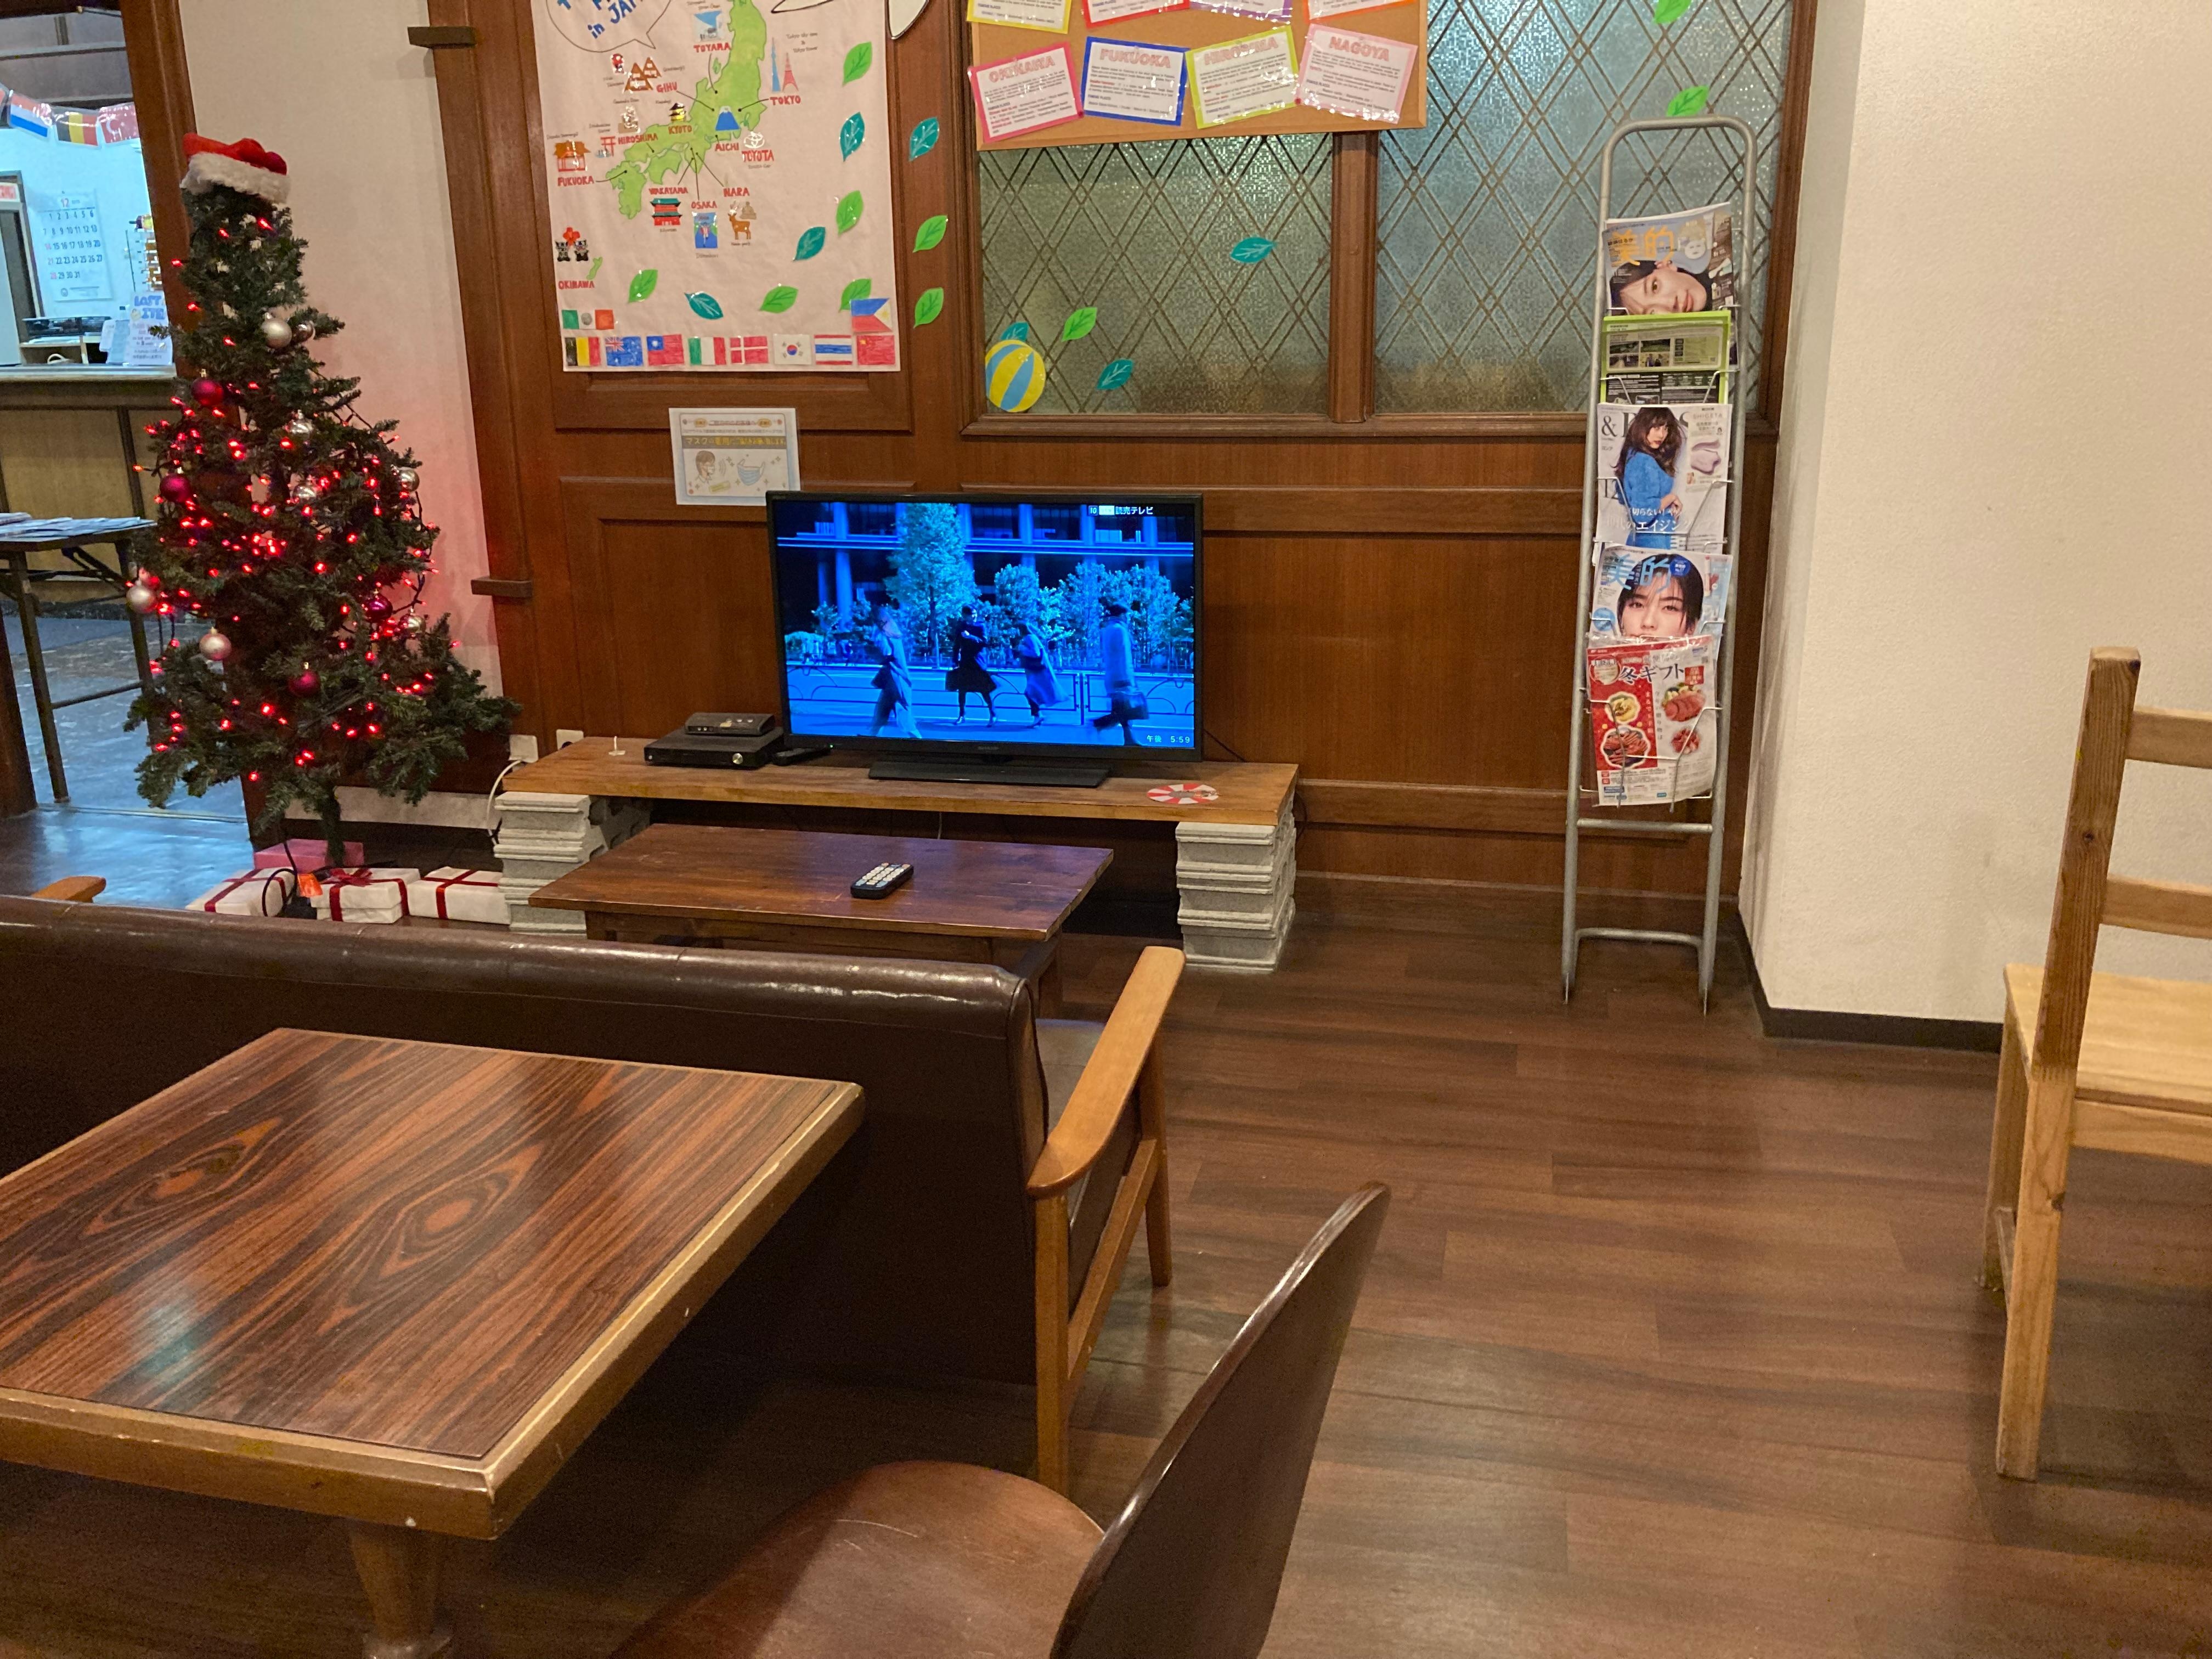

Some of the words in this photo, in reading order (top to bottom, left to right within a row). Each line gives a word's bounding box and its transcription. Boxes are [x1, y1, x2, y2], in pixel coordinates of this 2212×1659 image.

[588, 24, 605, 38] in
[608, 0, 636, 24] JA
[1329, 36, 1389, 61] NAGOYA
[1099, 48, 1171, 69] FUKUOKA
[770, 95, 801, 106] TOKYO
[668, 125, 692, 134] KYOTO
[715, 143, 739, 152] AICHI
[741, 149, 775, 162] TOYOTA
[557, 176, 595, 187] FUKUOKA
[723, 188, 750, 197] NARA
[691, 201, 717, 210] OSAKA
[558, 280, 595, 290] OKINAWA
[134, 295, 161, 306] LOST
[142, 308, 165, 319] ITE
[1115, 506, 1153, 515] 読売テレビ
[1605, 552, 1672, 594] 美的
[1621, 663, 1684, 684] 冬ギフト
